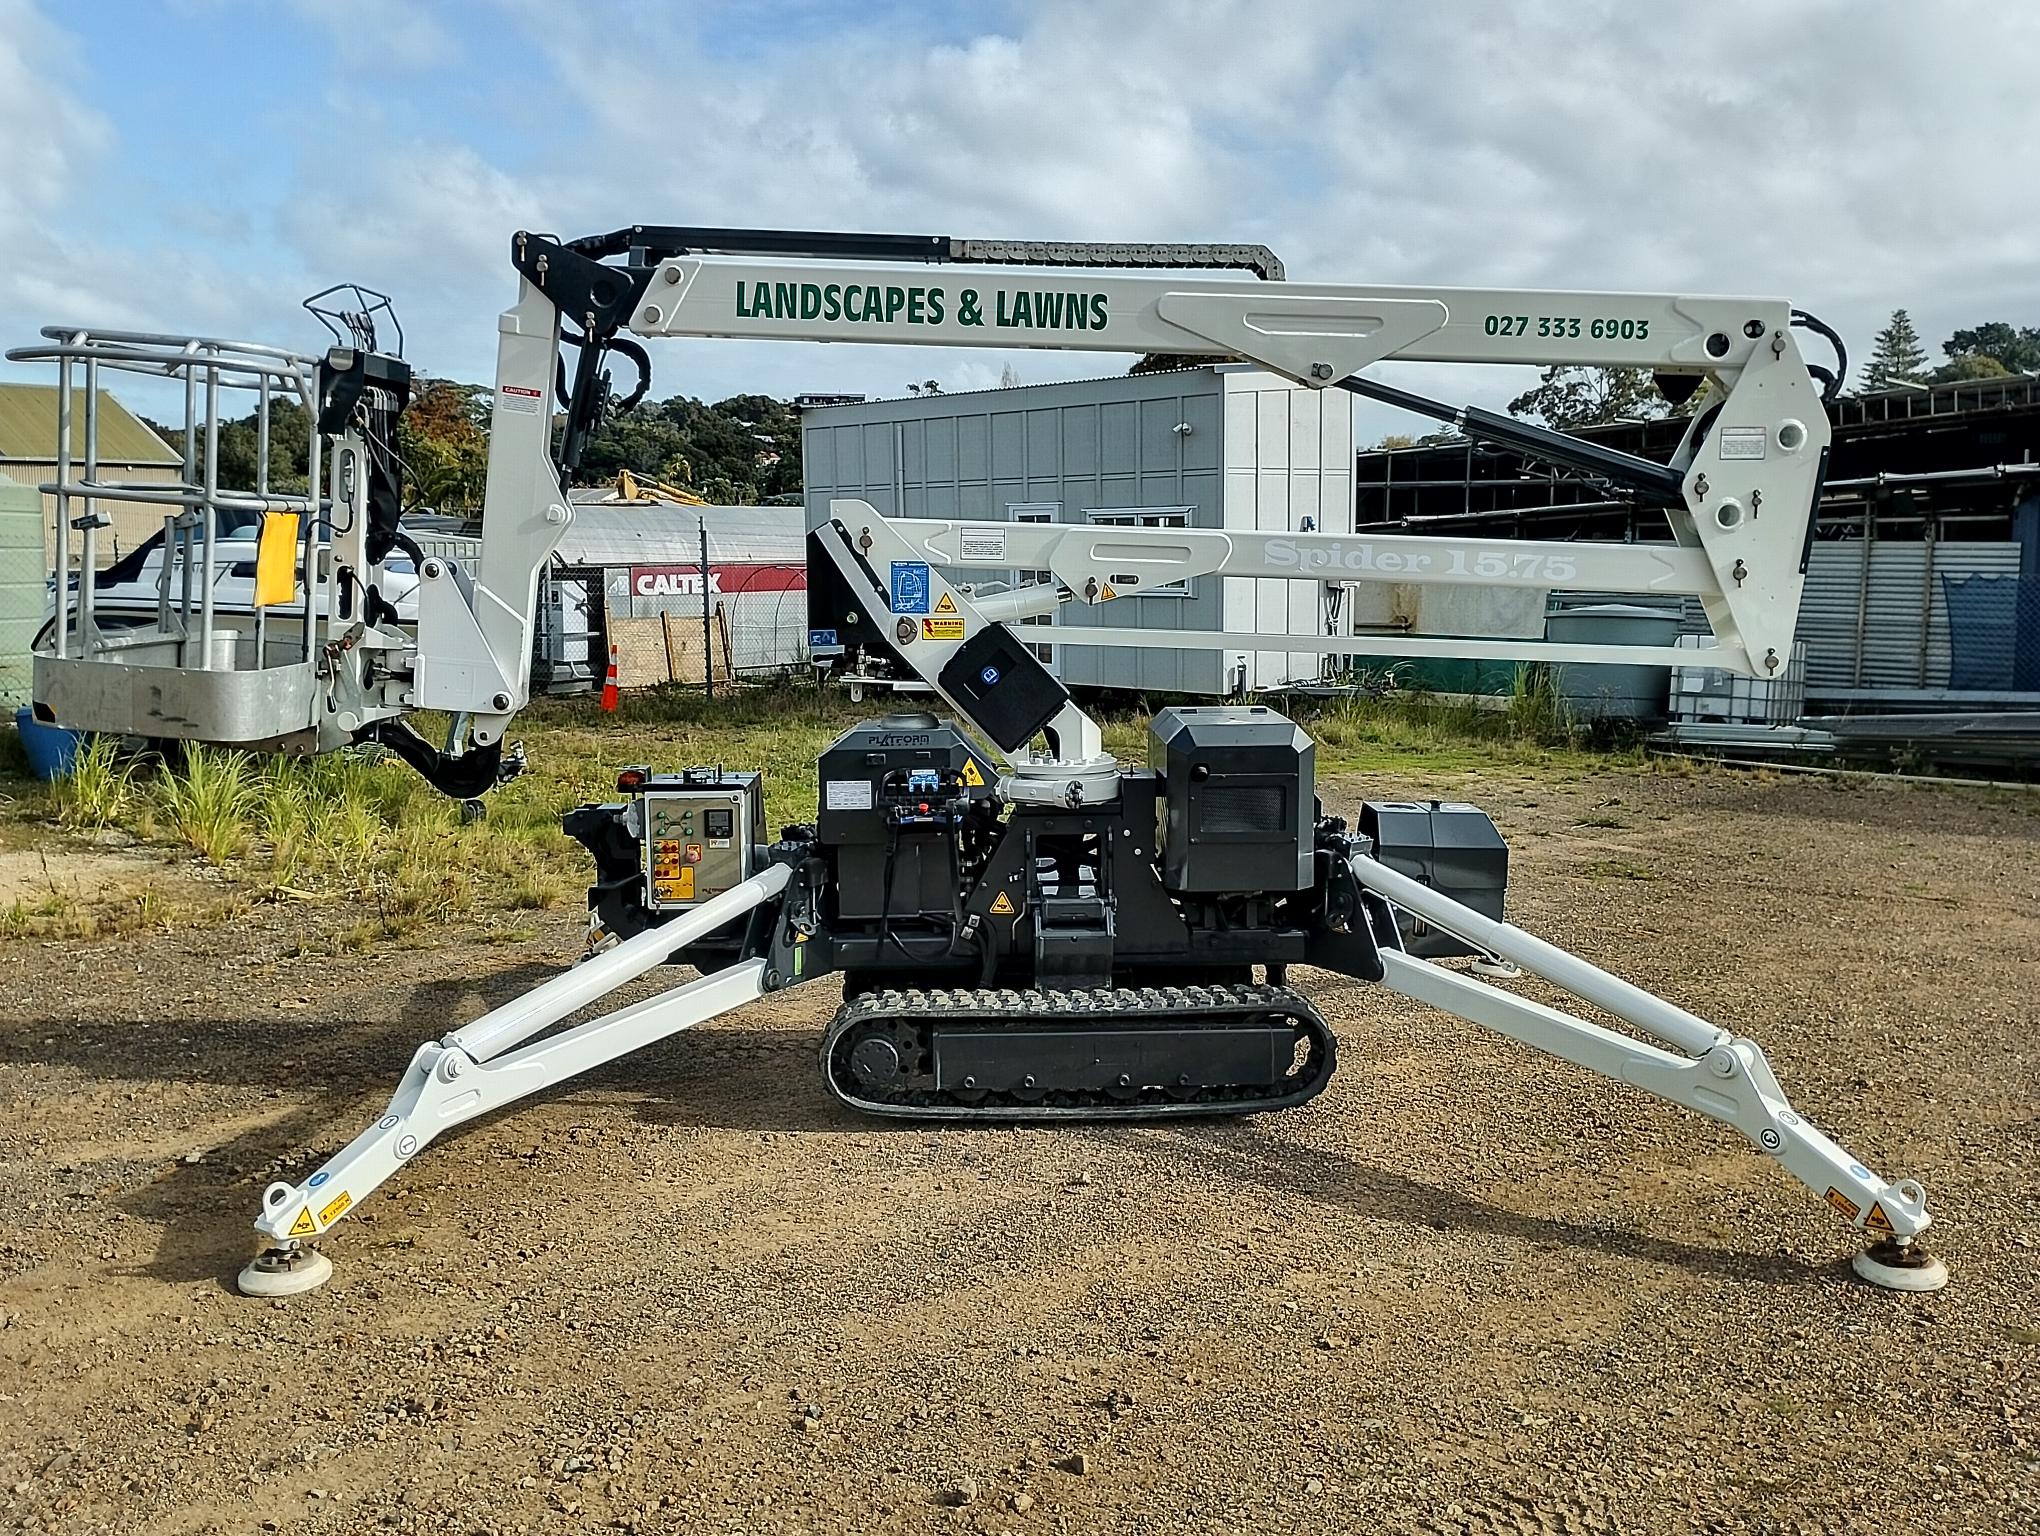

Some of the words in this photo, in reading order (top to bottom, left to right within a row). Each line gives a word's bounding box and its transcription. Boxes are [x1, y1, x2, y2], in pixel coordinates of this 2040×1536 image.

[735, 280, 946, 325] LANDSCAPES
[957, 289, 985, 327] &
[995, 290, 1109, 331] LAWNS
[1484, 315, 1529, 337] 027
[1537, 317, 1581, 338] 333
[1590, 318, 1649, 340] 6903
[504, 387, 531, 395] CAUTION
[1264, 539, 1432, 574] Spider
[1444, 549, 1577, 581] 15.75
[636, 573, 722, 596] CALTEX
[868, 733, 930, 746] PLATFORM
[1763, 1132, 1777, 1146] 3
